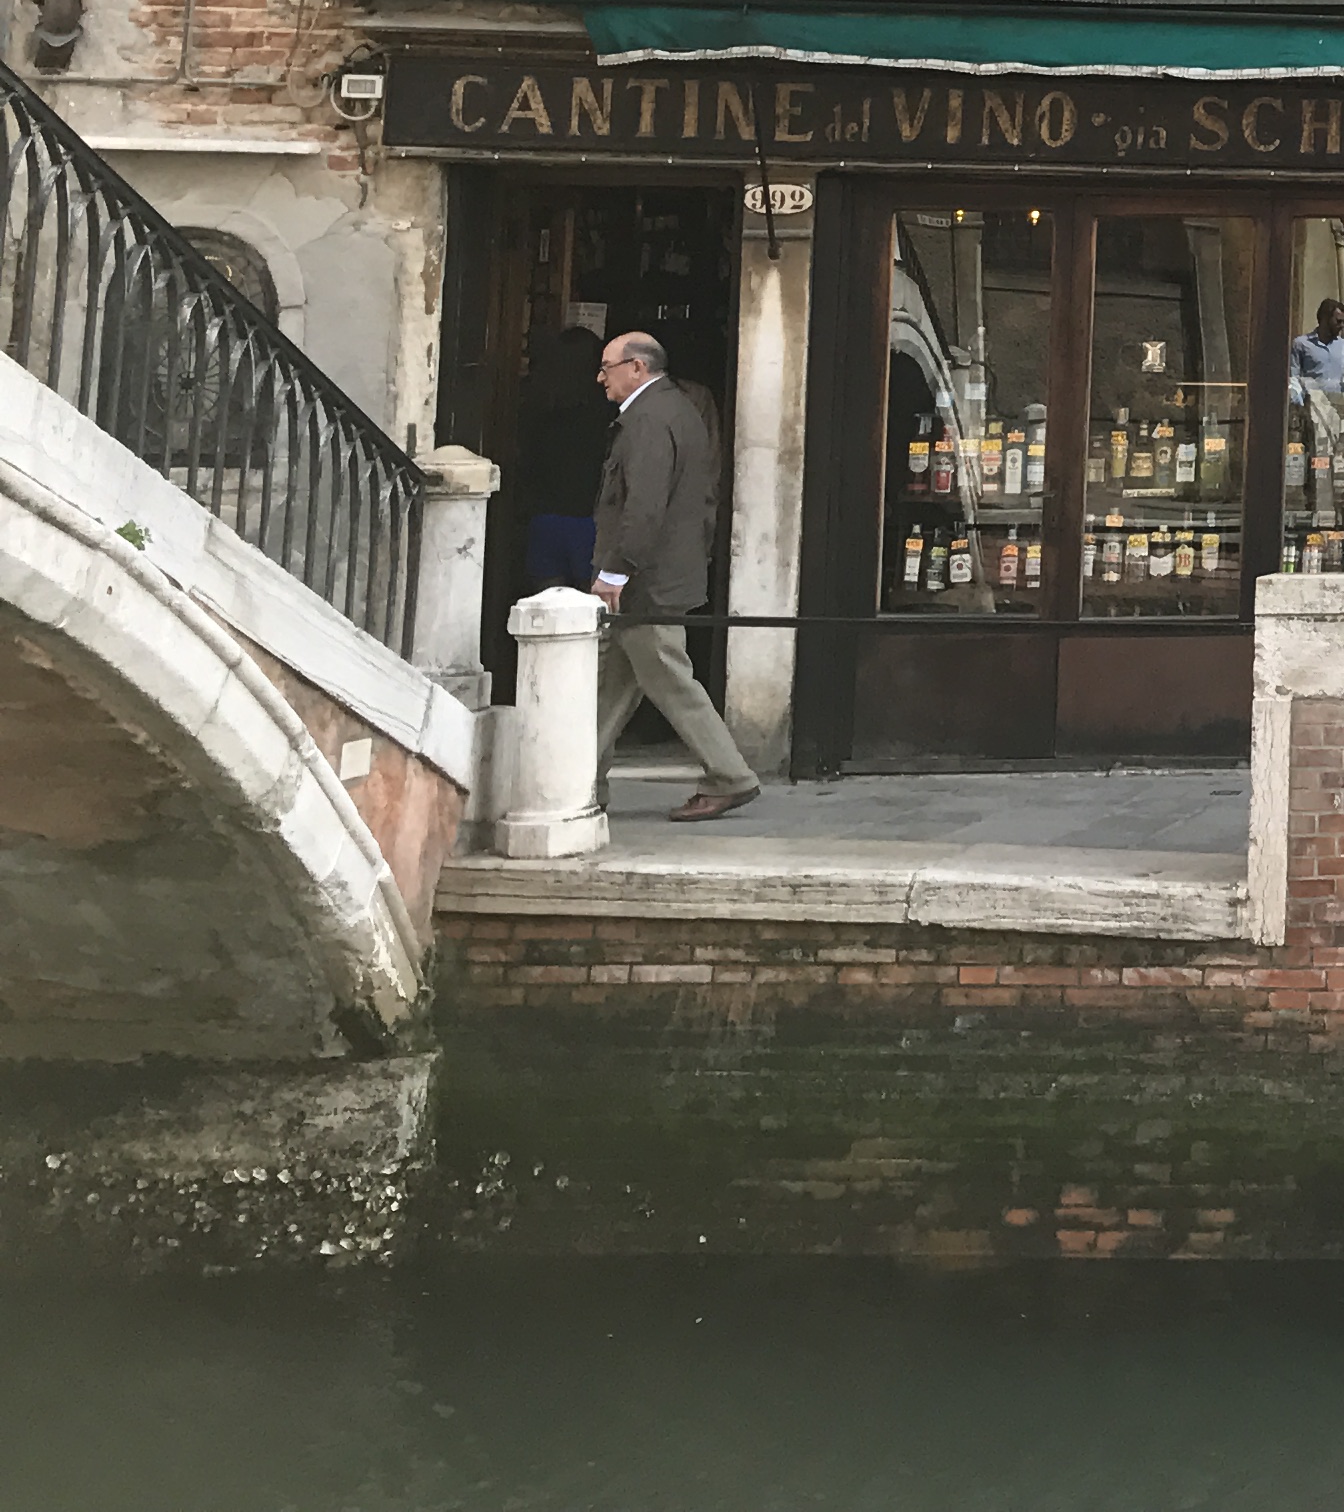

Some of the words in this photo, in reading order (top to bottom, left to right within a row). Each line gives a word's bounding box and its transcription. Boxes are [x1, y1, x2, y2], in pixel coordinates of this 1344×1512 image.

[450, 74, 815, 142] CANTINE
[824, 97, 871, 143] del
[891, 88, 1077, 148] VINO
[751, 190, 805, 210] 992
